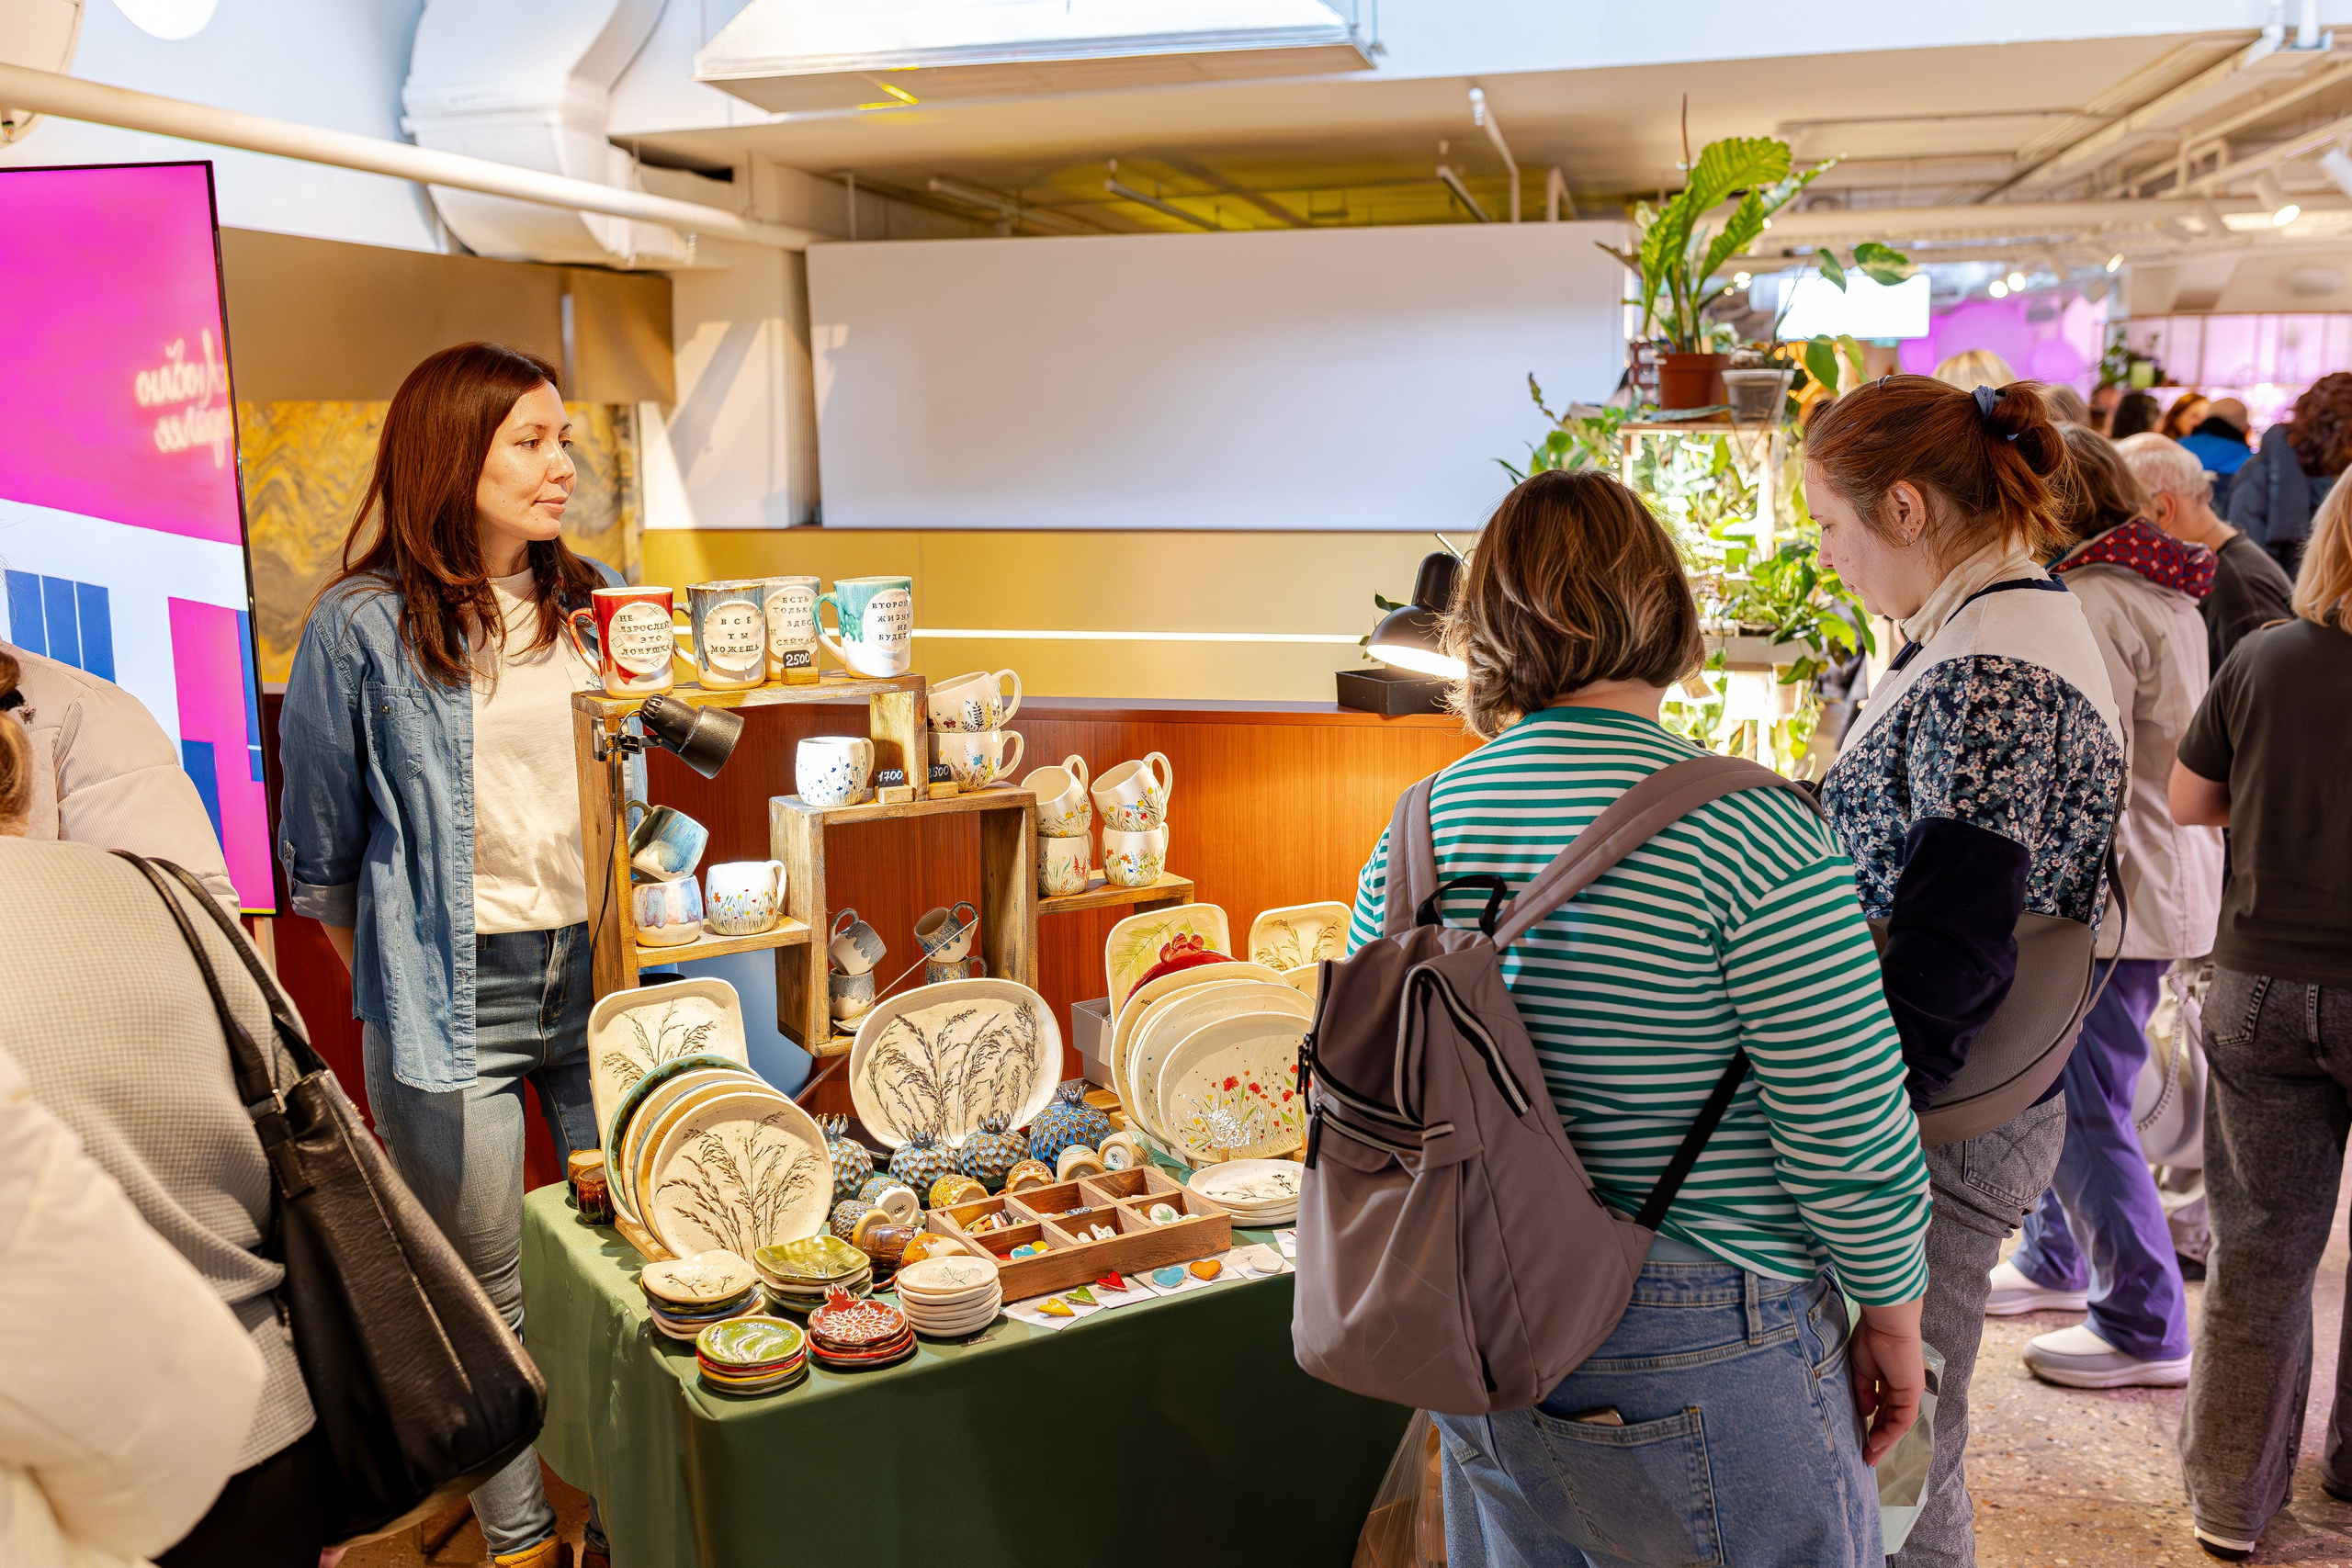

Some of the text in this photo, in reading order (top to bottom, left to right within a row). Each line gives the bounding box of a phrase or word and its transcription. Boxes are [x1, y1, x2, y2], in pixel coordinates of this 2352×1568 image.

[871, 599, 909, 609] ВТОРОЙ
[619, 615, 634, 623] НЕ
[720, 615, 752, 626] ВСЁ
[786, 619, 814, 627] ЗДЕС
[619, 620, 670, 634] ВЗРОСЛЕЙ
[639, 635, 662, 644] ЭТО
[727, 632, 749, 640] ТЫ
[878, 633, 908, 642] БУДЕТ
[775, 637, 816, 646] СЕЙЧАС
[710, 644, 760, 655] МОЖЕШЬ
[786, 652, 810, 667] 2500
[877, 770, 904, 782] 1700
